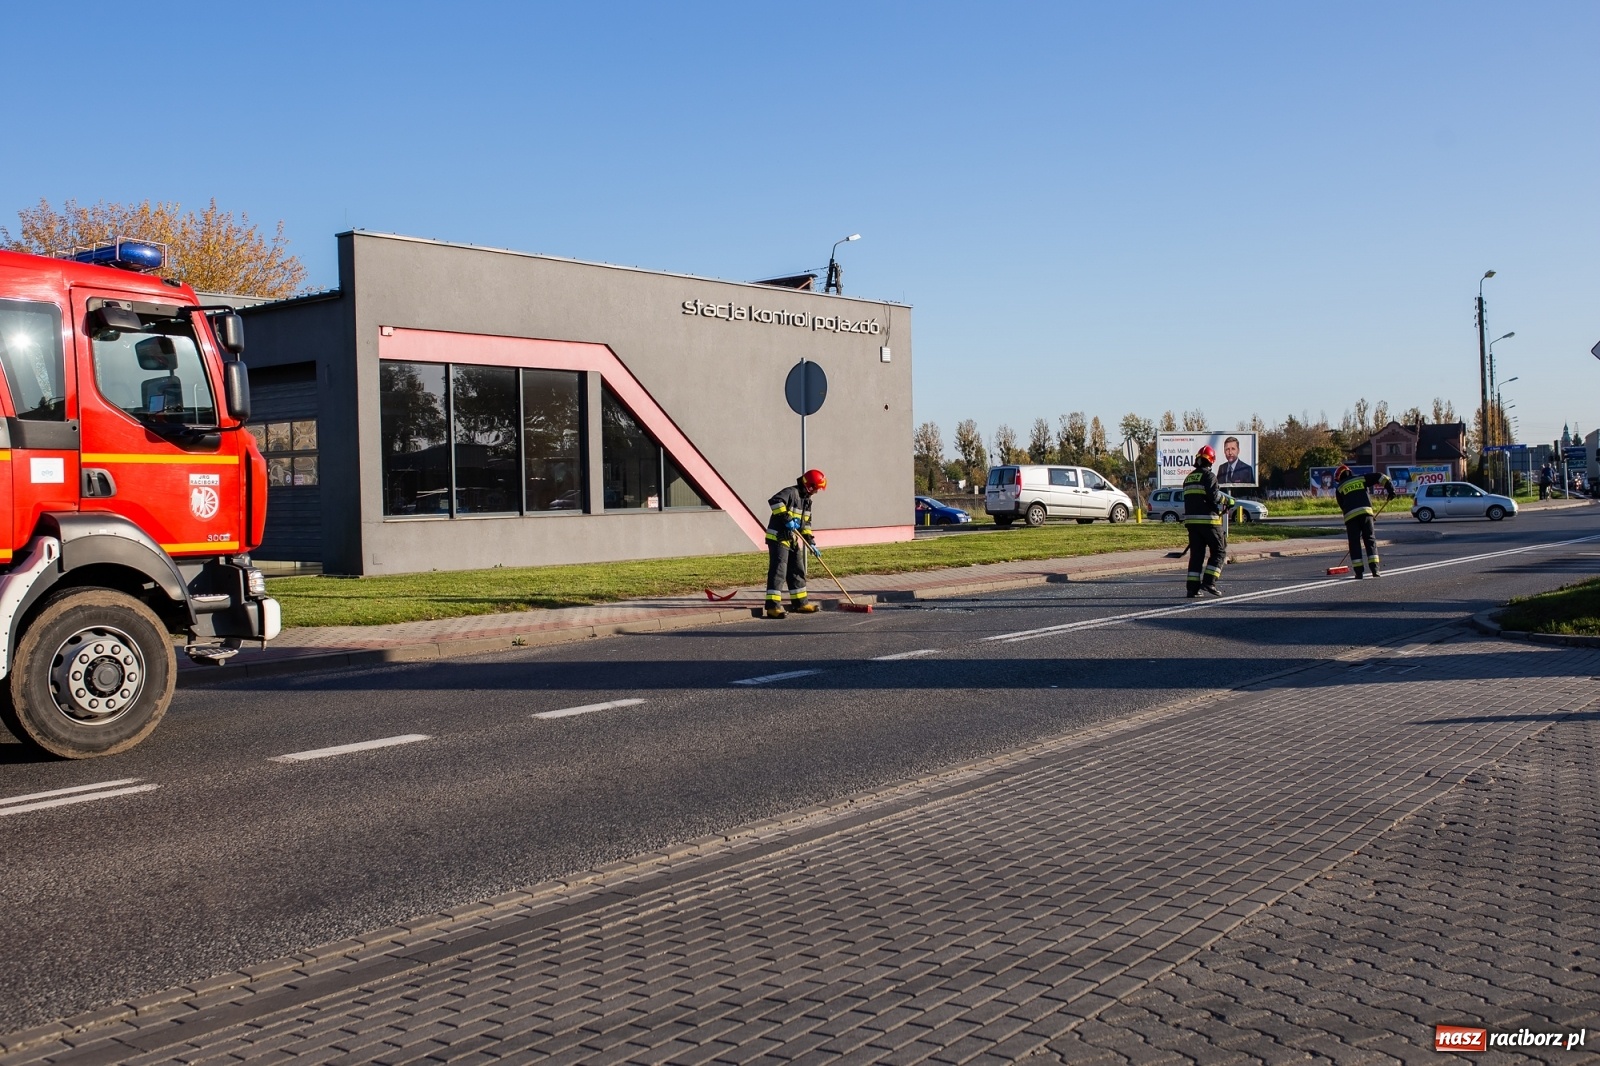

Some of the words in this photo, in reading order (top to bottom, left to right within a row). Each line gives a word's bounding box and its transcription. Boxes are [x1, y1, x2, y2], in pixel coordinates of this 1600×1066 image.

[682, 299, 747, 321] stacja
[749, 305, 811, 328] kontroli
[1163, 455, 1195, 467] MIGAL
[1163, 468, 1176, 476] Nasz
[1177, 468, 1192, 476] Senat
[1418, 473, 1444, 485] 2399
